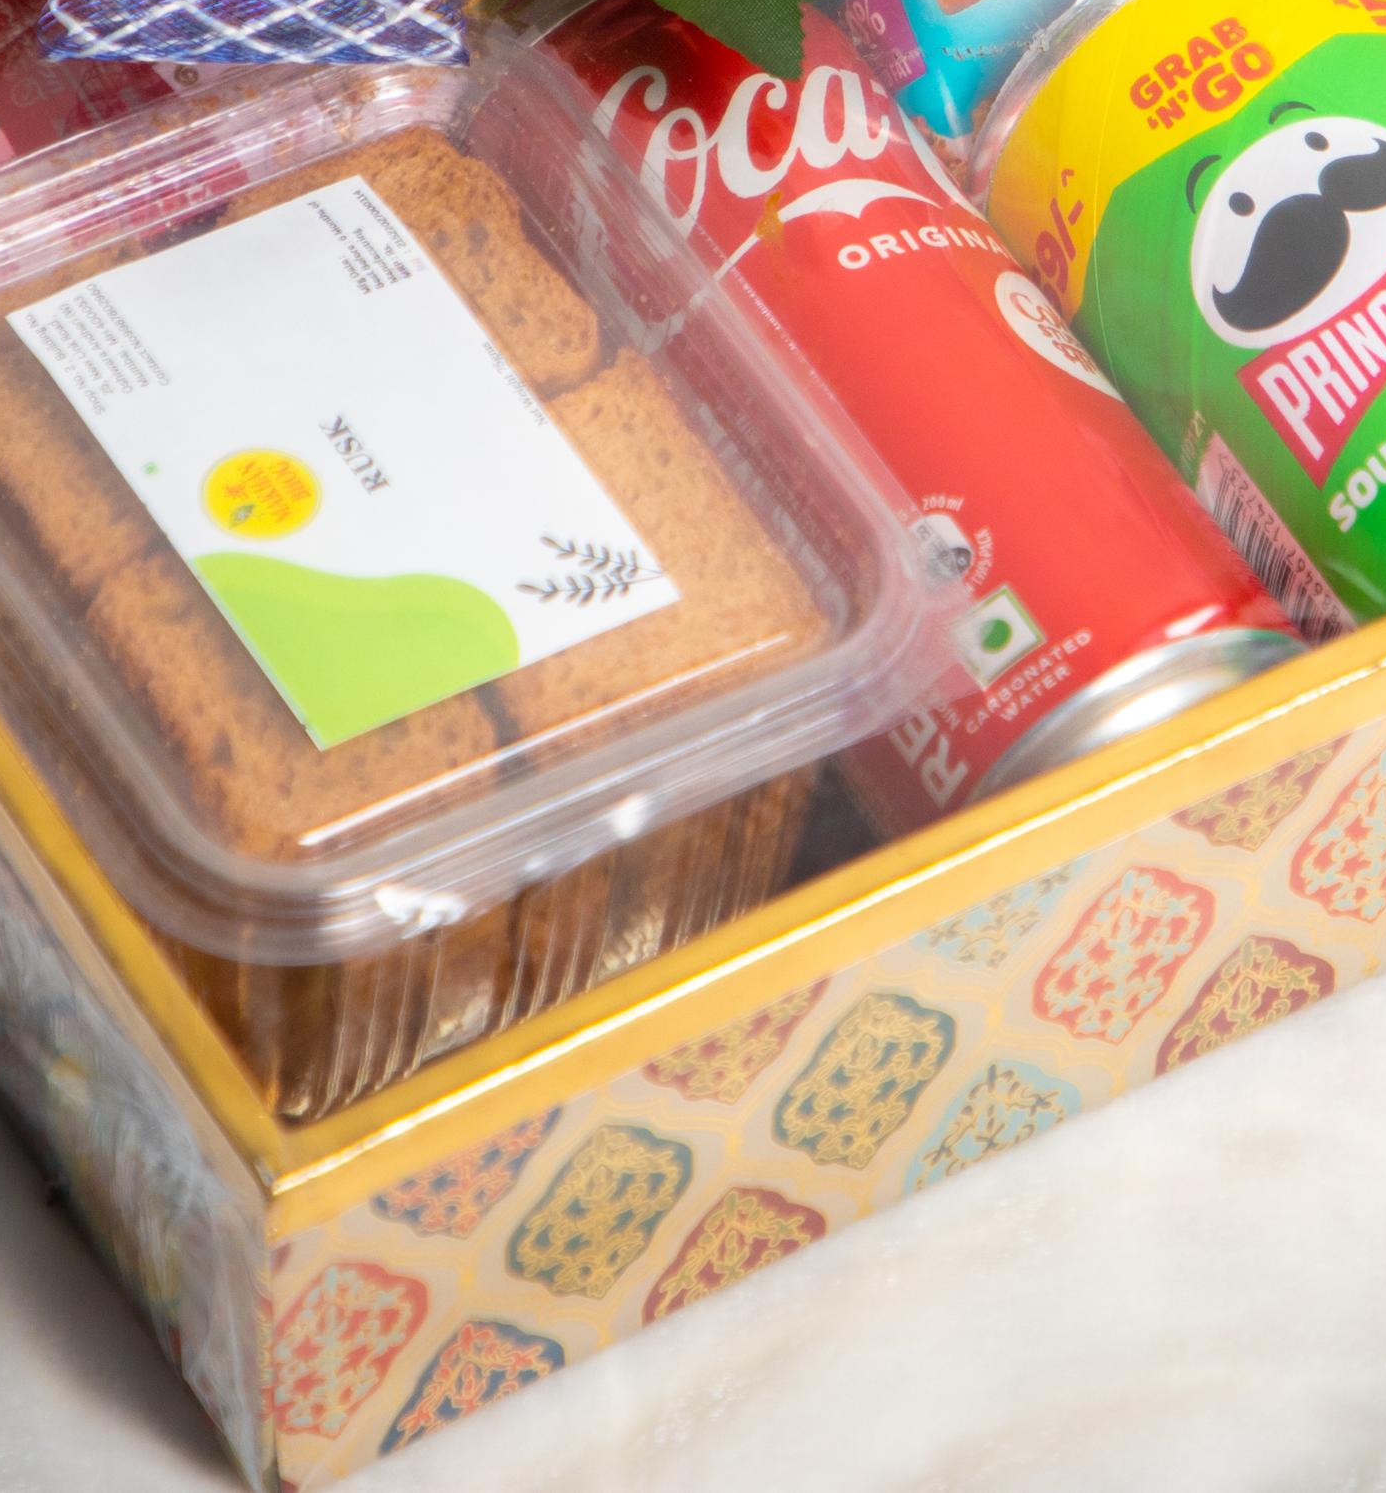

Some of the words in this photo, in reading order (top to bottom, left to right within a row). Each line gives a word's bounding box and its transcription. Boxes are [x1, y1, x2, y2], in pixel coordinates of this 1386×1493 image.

[1129, 16, 1248, 110] GRAB
[1191, 42, 1276, 113] GO
[837, 224, 1013, 270] ORIGINA
[318, 412, 393, 496] RUSK
[965, 627, 1092, 735] CARBONATED
[1000, 662, 1072, 723] WATER
